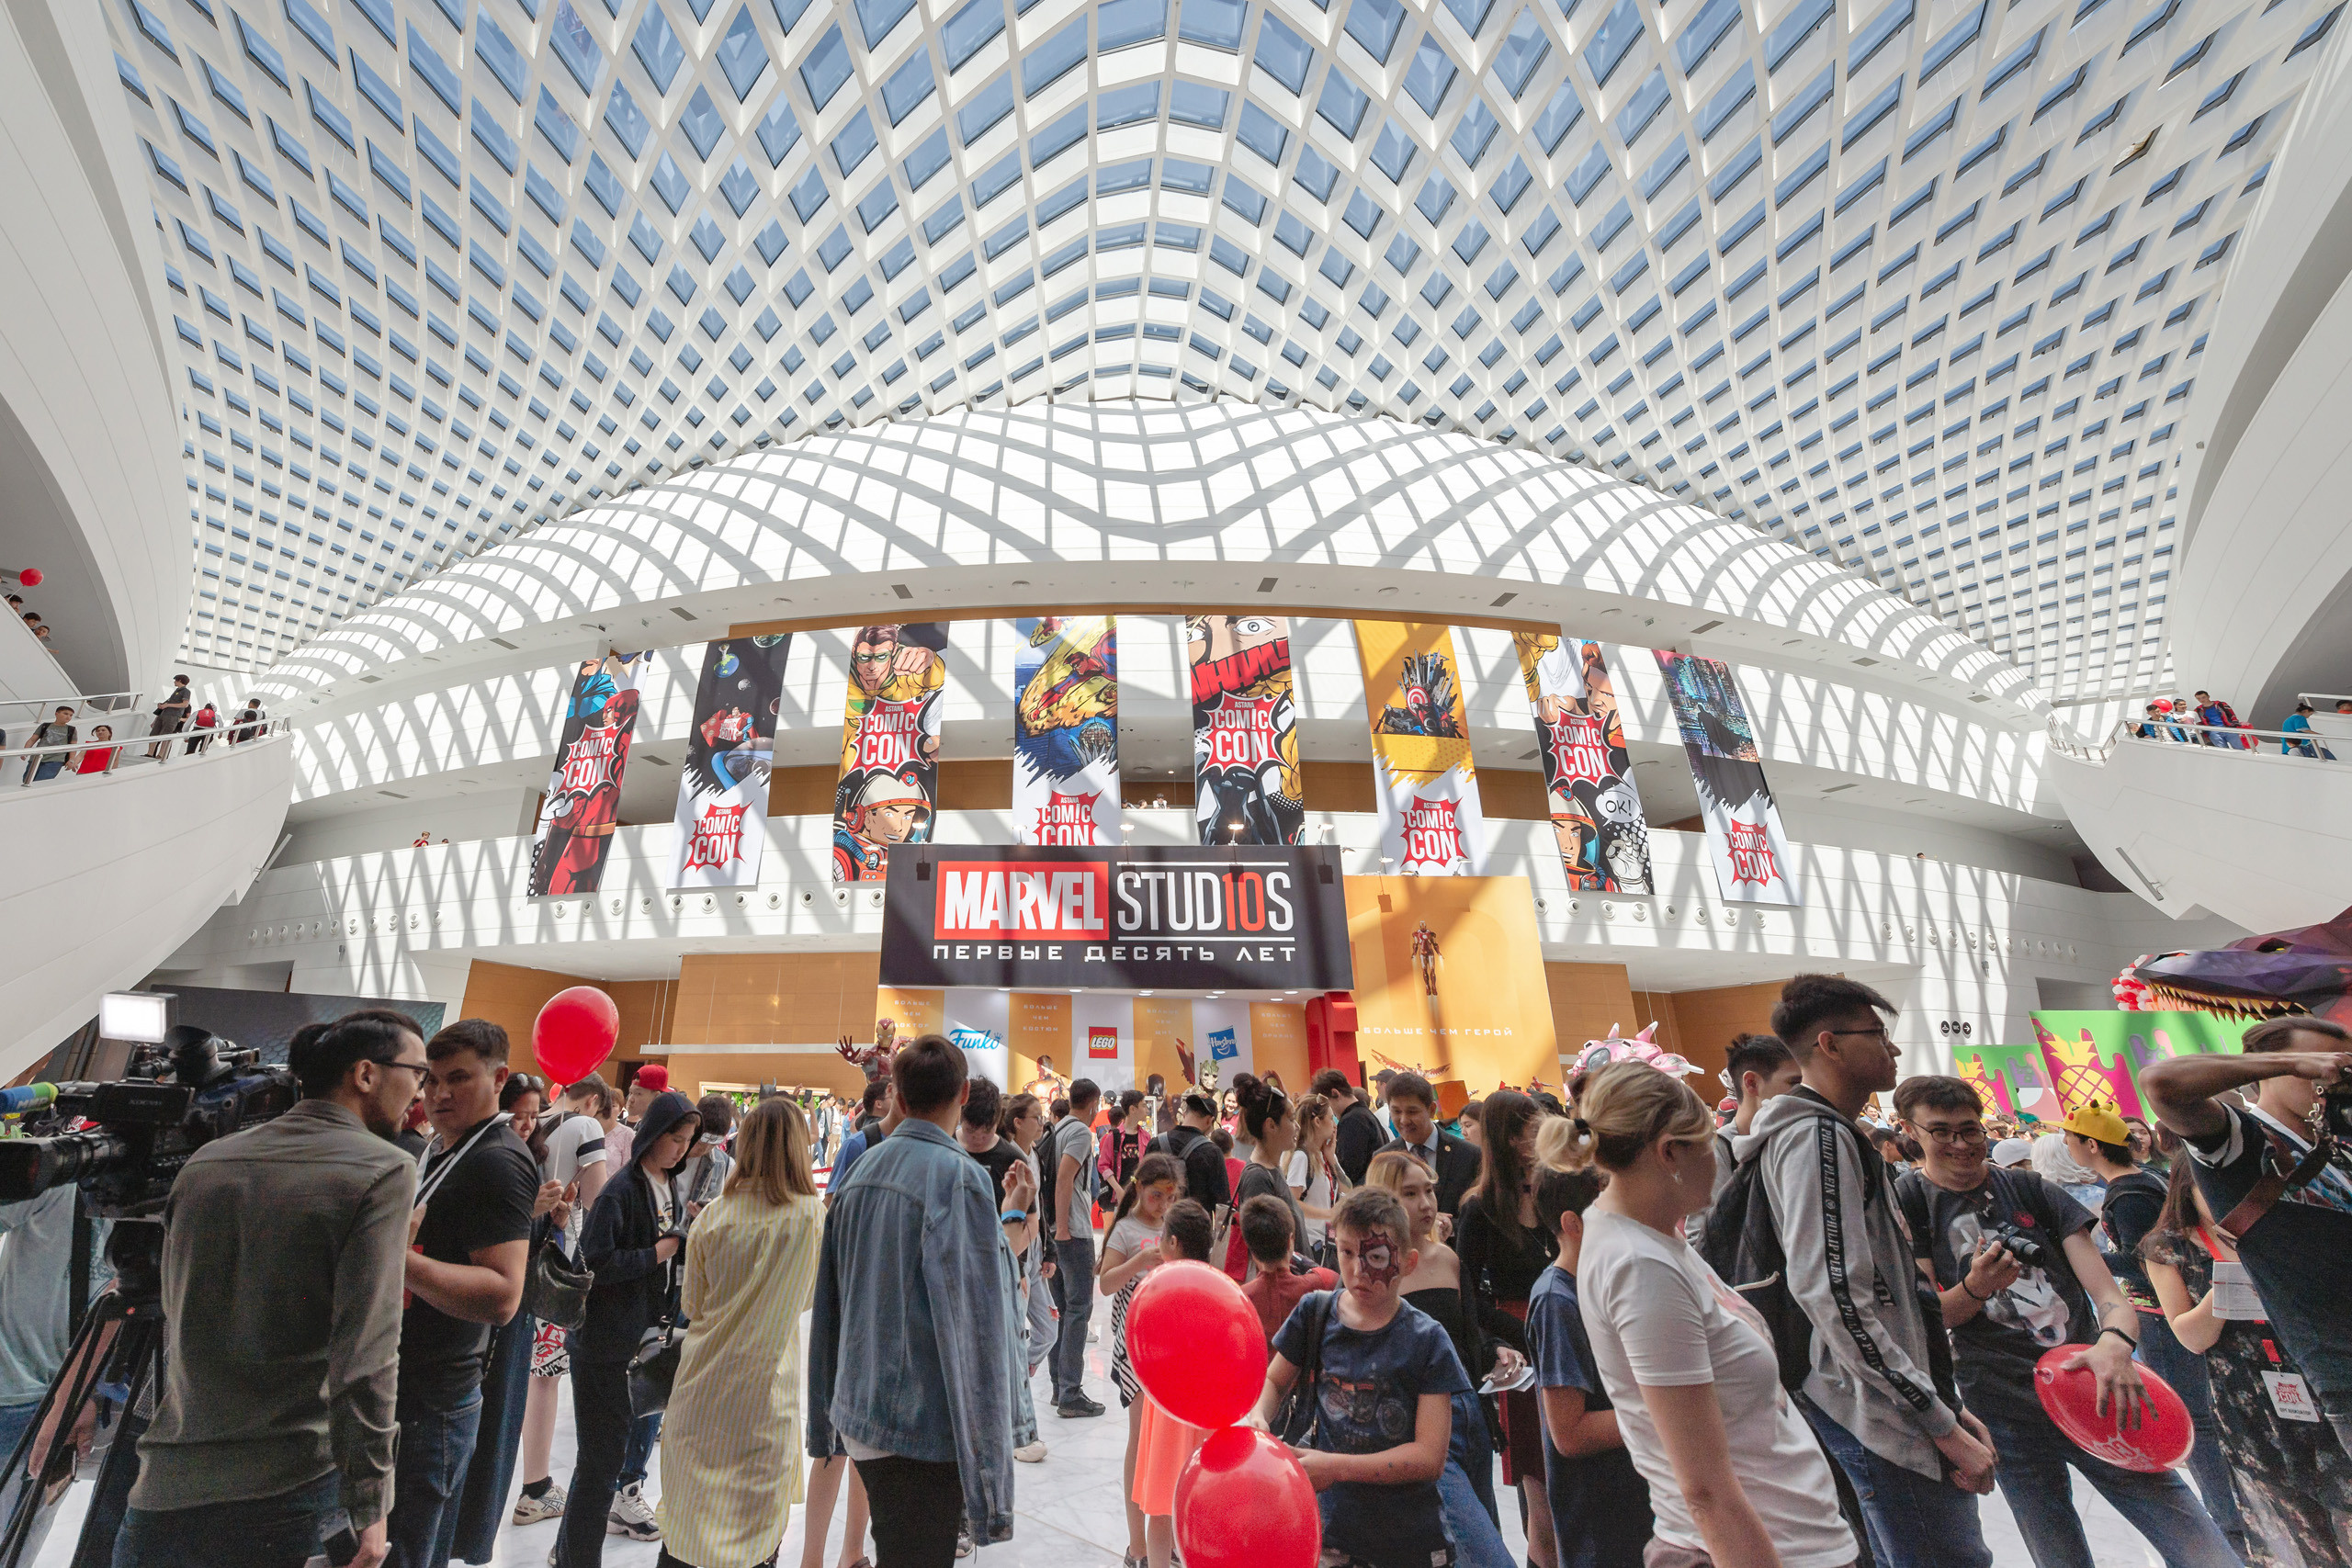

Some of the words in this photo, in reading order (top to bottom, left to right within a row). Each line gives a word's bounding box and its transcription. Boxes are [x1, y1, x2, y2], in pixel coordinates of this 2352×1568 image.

[865, 712, 915, 733] COM!C
[1215, 709, 1268, 729] COM!C
[1216, 730, 1269, 762] CON
[1555, 726, 1601, 747] COM!C
[572, 737, 612, 759] COM!C
[862, 733, 911, 765] CON
[1558, 745, 1607, 777] CON
[566, 757, 607, 788] CON
[1042, 804, 1091, 824] COM!C
[1606, 799, 1632, 817] OK!
[697, 814, 740, 834] COM!C
[1407, 809, 1454, 829] COM!C
[1042, 825, 1089, 845] CON
[1409, 829, 1456, 860] CON
[1729, 831, 1767, 852] COM!C
[694, 834, 736, 863] CON
[1734, 851, 1773, 880] CON
[944, 871, 1103, 930] MARVEL
[933, 945, 1062, 961] ПЕРВЫЕ
[1084, 946, 1215, 963] ДЕСЯТЬ
[1237, 946, 1295, 962] ЛЕТ
[949, 1029, 1001, 1049] Funko
[1208, 1036, 1237, 1048] Hasbro
[1464, 1027, 1512, 1036] ГЕРОЙ
[1091, 1036, 1115, 1049] LEGO
[1821, 1128, 1834, 1163] PHILIP
[1825, 1164, 1835, 1197] PLEIN
[1826, 1213, 1839, 1252] PHILIP
[1829, 1253, 1842, 1284] PLEIN
